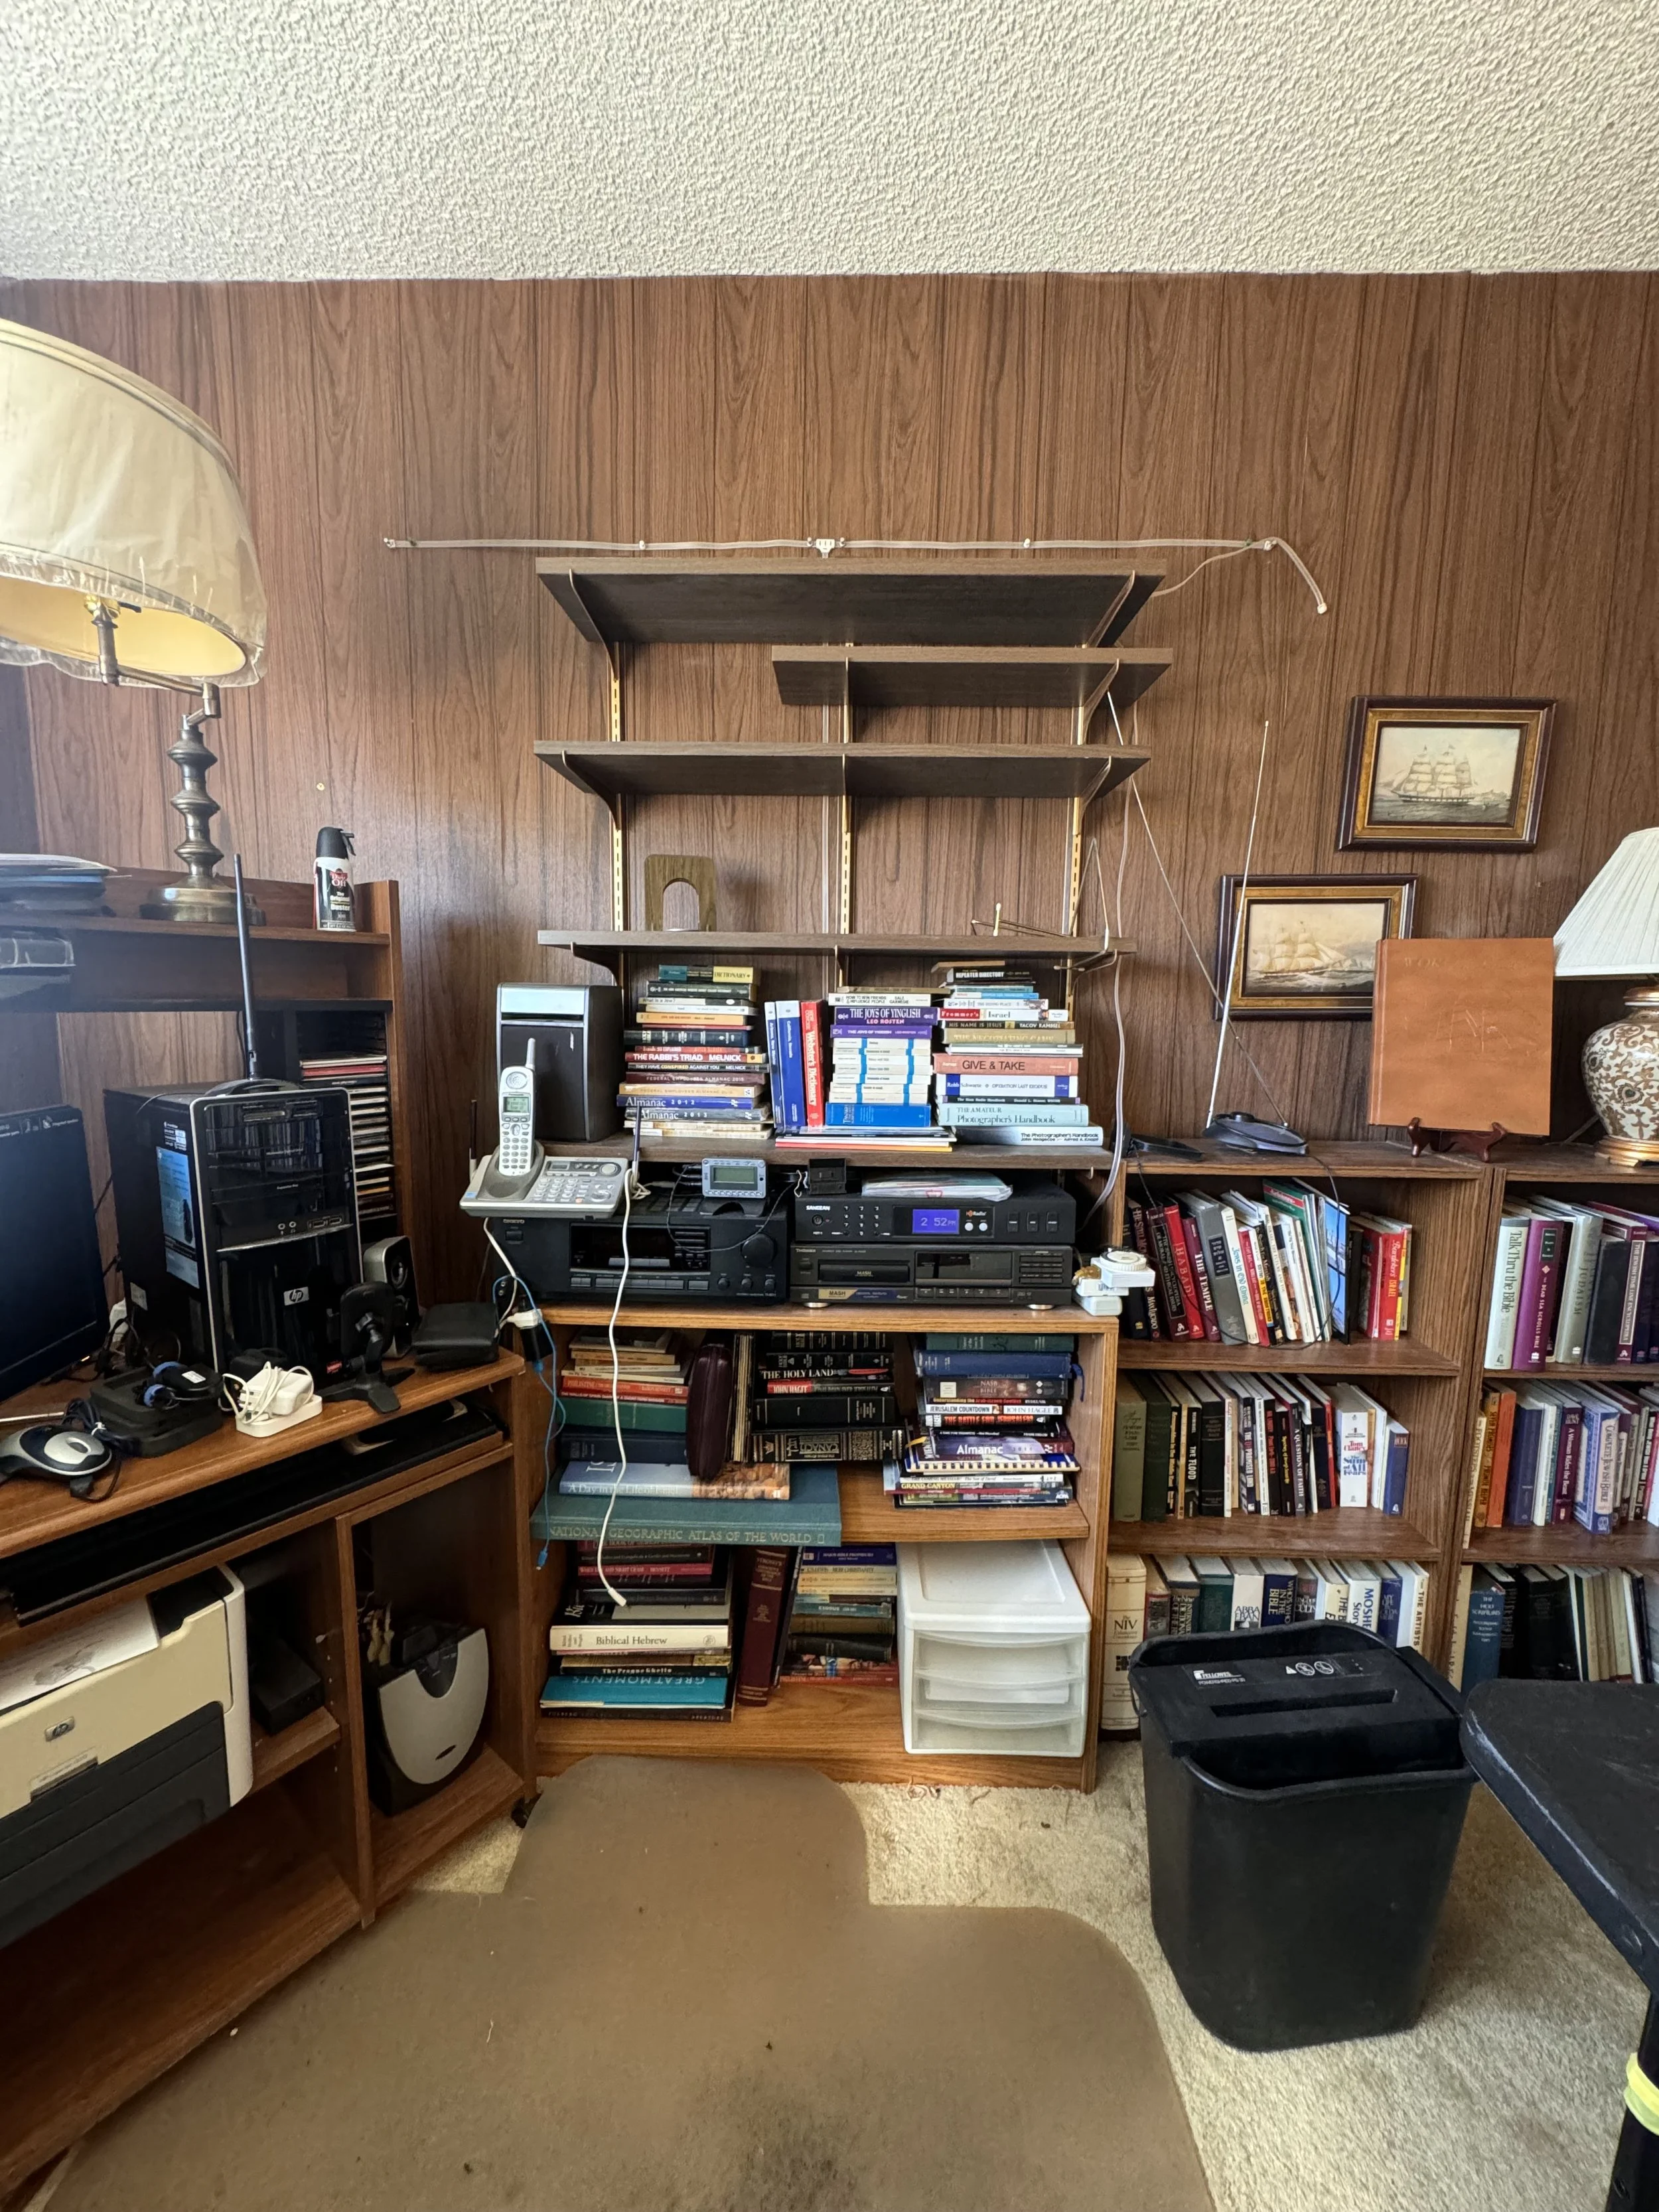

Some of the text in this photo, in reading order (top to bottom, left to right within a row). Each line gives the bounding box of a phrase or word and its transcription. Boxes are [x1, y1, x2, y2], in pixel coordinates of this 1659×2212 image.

[850, 1009, 920, 1019] THE JOYS OF YINGLISH
[806, 1030, 817, 1106] Webster's Dictionary
[962, 1061, 1025, 1070] GIVE & TAKE
[626, 1097, 666, 1106] Almanac
[641, 1110, 679, 1119] Almanac
[958, 1115, 1012, 1125] Photographer's
[1232, 1248, 1241, 1264] Jews
[1176, 1248, 1191, 1293] HABAD
[1501, 1230, 1522, 1313] Talk Thru the Bible
[1194, 1252, 1213, 1311] THE TEMPLE
[1388, 1280, 1398, 1297] ISRAEL
[289, 1290, 303, 1302] hp
[1573, 1266, 1588, 1315] JUDAISM
[762, 1370, 781, 1379] THE
[784, 1369, 806, 1378] HOLY
[944, 1416, 956, 1425] THE
[981, 1416, 995, 1425] FOR
[957, 1444, 1003, 1454] Almanac
[1294, 1434, 1303, 1467] QUESTION
[1471, 1429, 1483, 1472] FOOTSTEPS
[1565, 1434, 1574, 1454] Woman
[1188, 1459, 1196, 1480] FLOOD
[568, 1484, 578, 1493] A
[579, 1485, 595, 1494] Day
[1600, 1483, 1611, 1502] BIBLE
[609, 1528, 812, 1543] GEOGRAPHIC ATLAS OF THE WORLD
[1236, 1605, 1260, 1614] ABBA
[1267, 1588, 1279, 1615] BIBLE
[1284, 1580, 1294, 1624] WHO'S WHO
[1362, 1588, 1374, 1628] MOSHE
[1115, 1620, 1137, 1630] NIV
[1413, 1611, 1423, 1647] ARTISTS
[52, 1722, 69, 1737] hp
